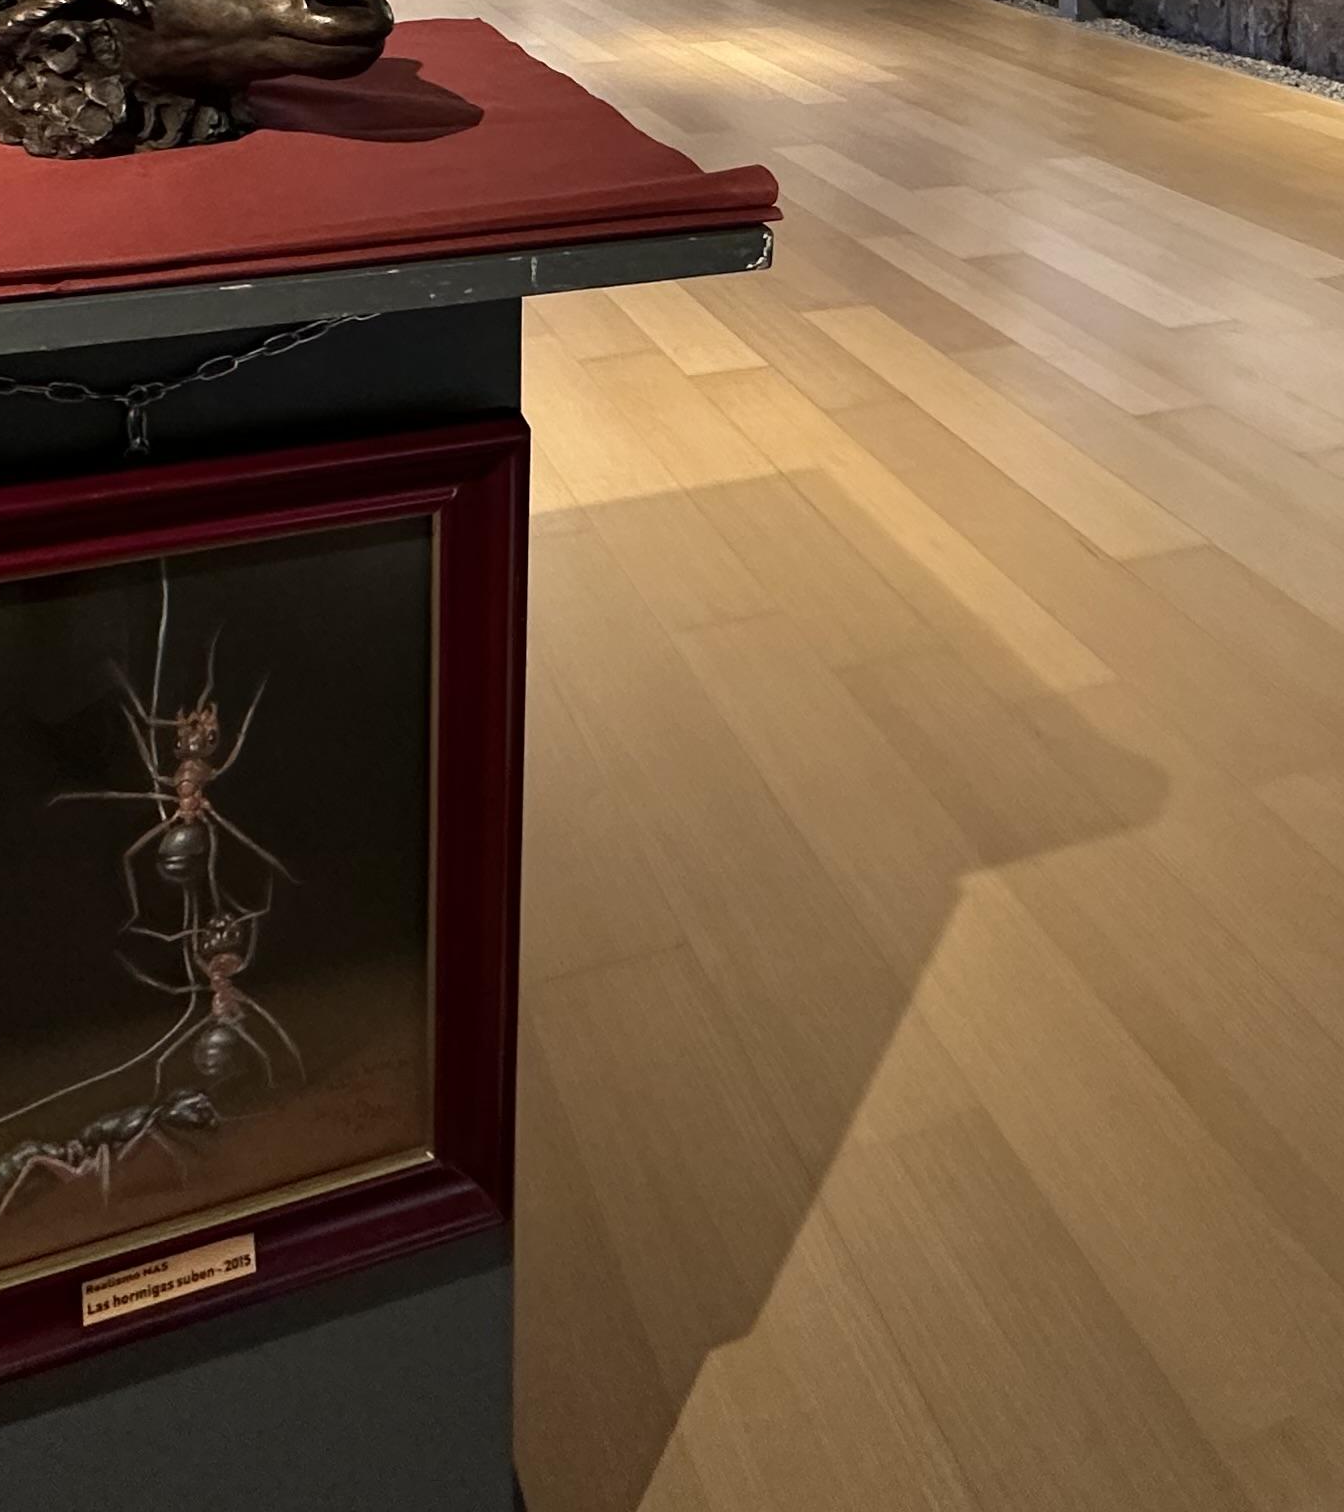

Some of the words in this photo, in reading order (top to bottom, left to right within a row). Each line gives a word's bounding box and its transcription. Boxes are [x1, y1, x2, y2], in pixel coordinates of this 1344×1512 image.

[86, 1272, 140, 1294] Realismo
[87, 1299, 110, 1315] Las
[113, 1281, 174, 1308] hormigas
[177, 1267, 214, 1287] suben
[224, 1254, 252, 1273] 2015
